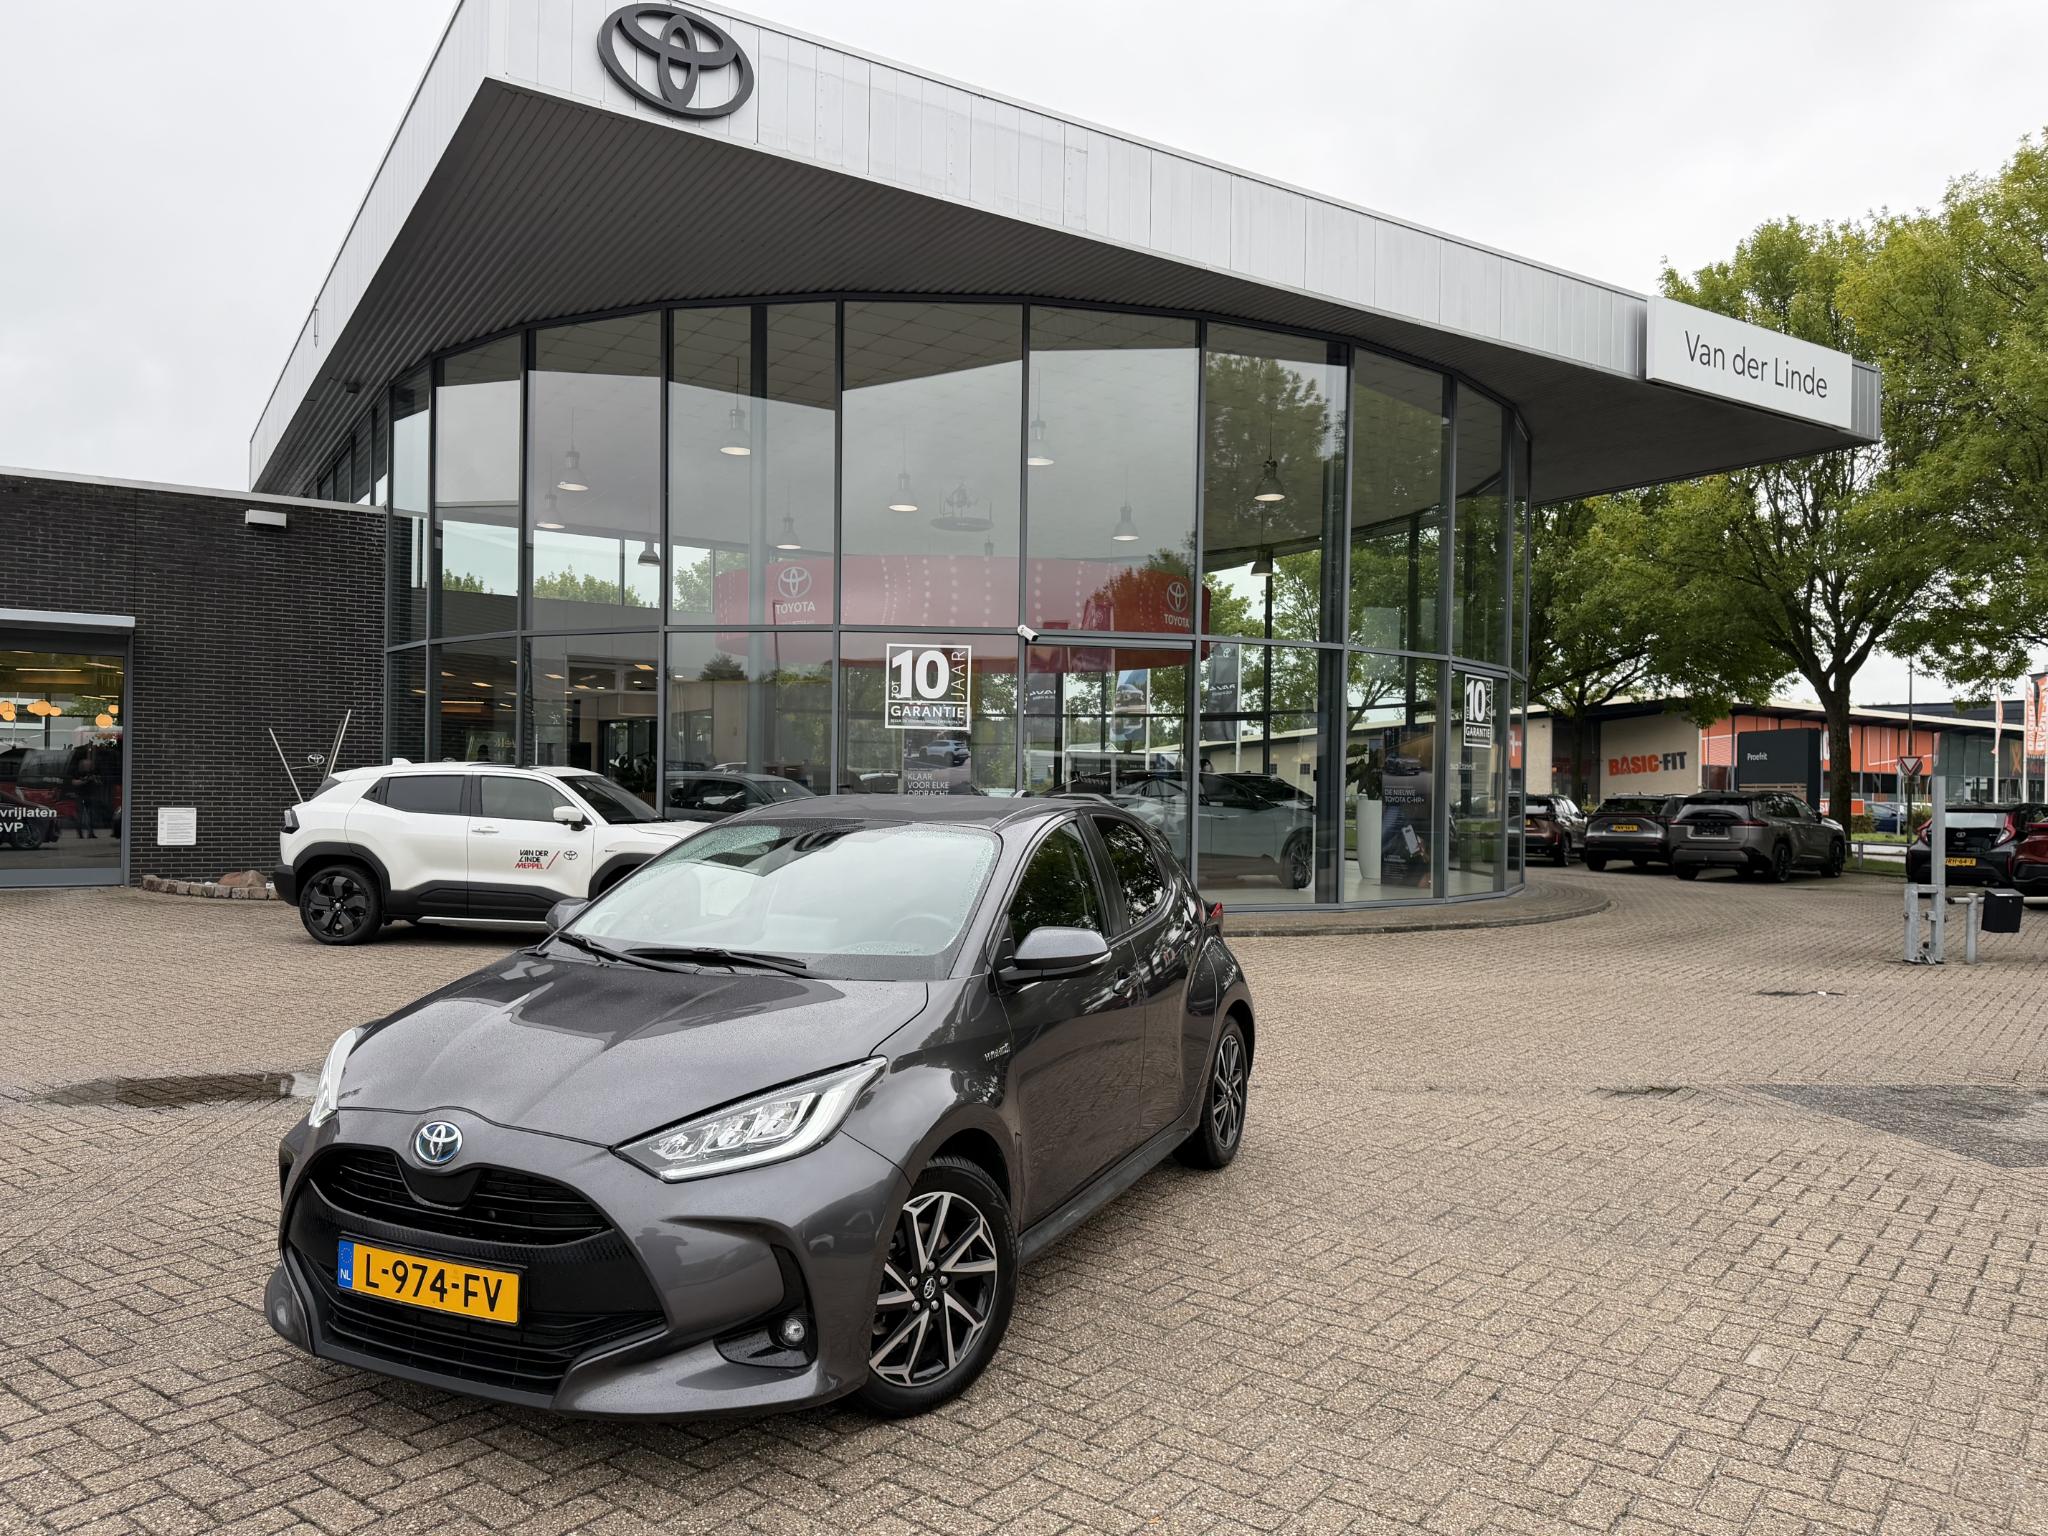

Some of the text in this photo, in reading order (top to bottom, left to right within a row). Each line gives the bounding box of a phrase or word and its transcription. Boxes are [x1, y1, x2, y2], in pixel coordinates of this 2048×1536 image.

[1685, 330, 1828, 398] Van der Linde
[775, 601, 816, 615] TOYOTA
[1164, 613, 1190, 628] TOYOTA
[891, 649, 950, 699] 10
[951, 650, 966, 700] JAAR
[1466, 679, 1486, 722] 10
[890, 705, 966, 718] GARANTIE
[1465, 726, 1491, 738] GARANTIE
[1608, 751, 1687, 776] BASIC-FIT
[907, 781, 950, 789] VOOR ELKE
[340, 1268, 352, 1281] NL
[365, 1253, 503, 1312] L-974-FV
